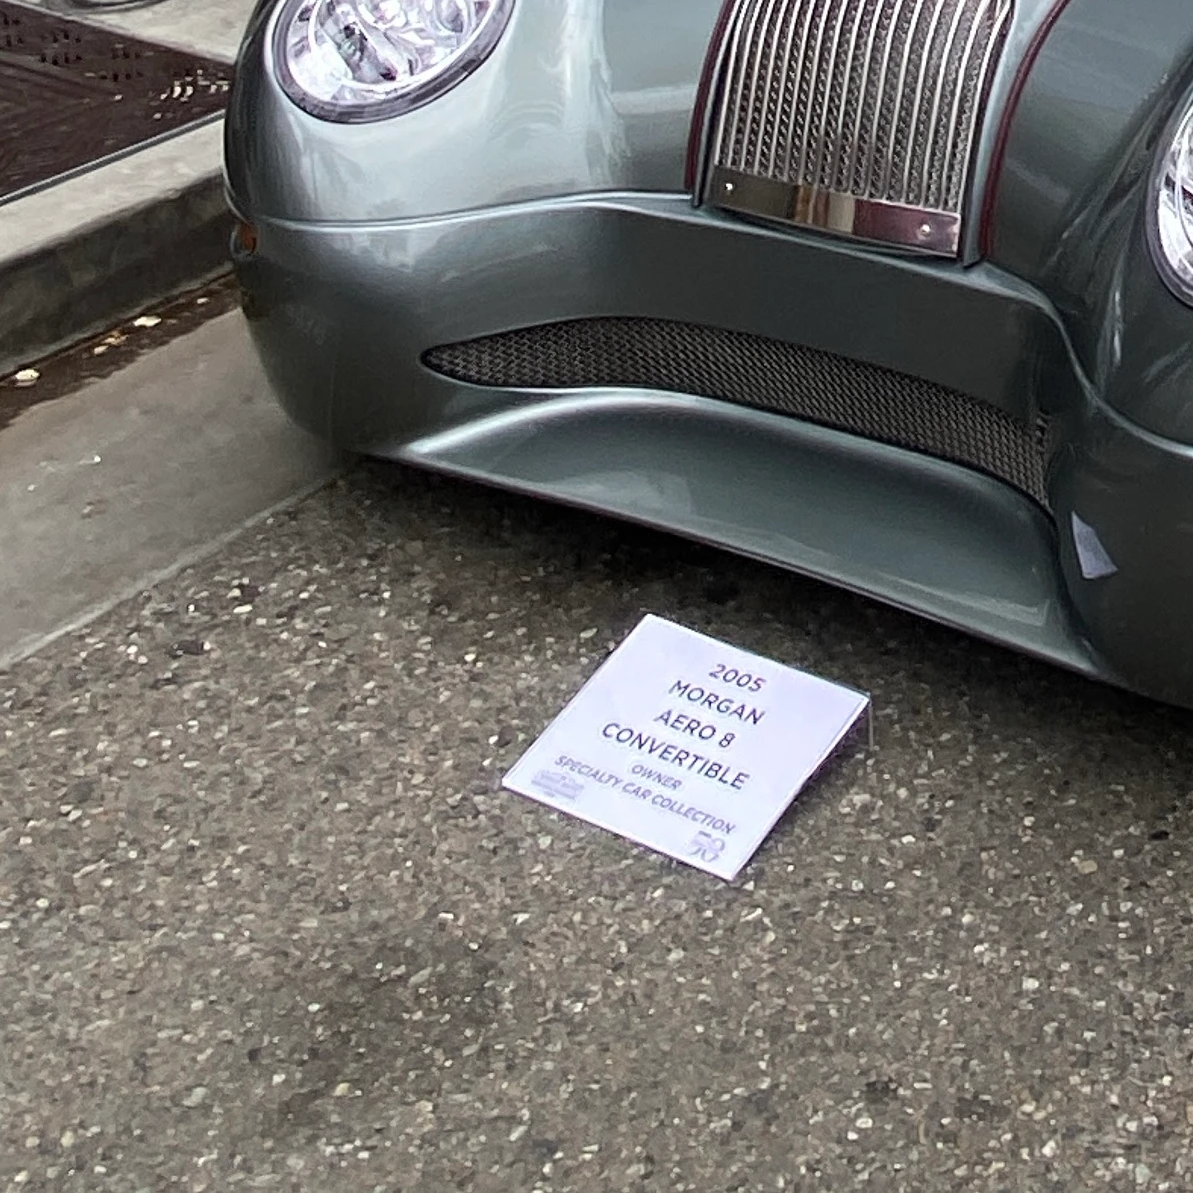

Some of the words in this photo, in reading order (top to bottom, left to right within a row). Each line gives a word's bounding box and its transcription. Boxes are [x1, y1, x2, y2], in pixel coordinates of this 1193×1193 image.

[709, 664, 767, 692] 2005
[669, 680, 766, 725] MORGAN
[653, 709, 717, 740] AERO
[718, 732, 736, 748] 8
[602, 722, 750, 790] CONVERTIBLE
[631, 764, 683, 790] OWNER
[554, 755, 623, 789] SPECIALTY
[622, 782, 652, 800] CAR
[651, 794, 736, 834] COLLECTION
